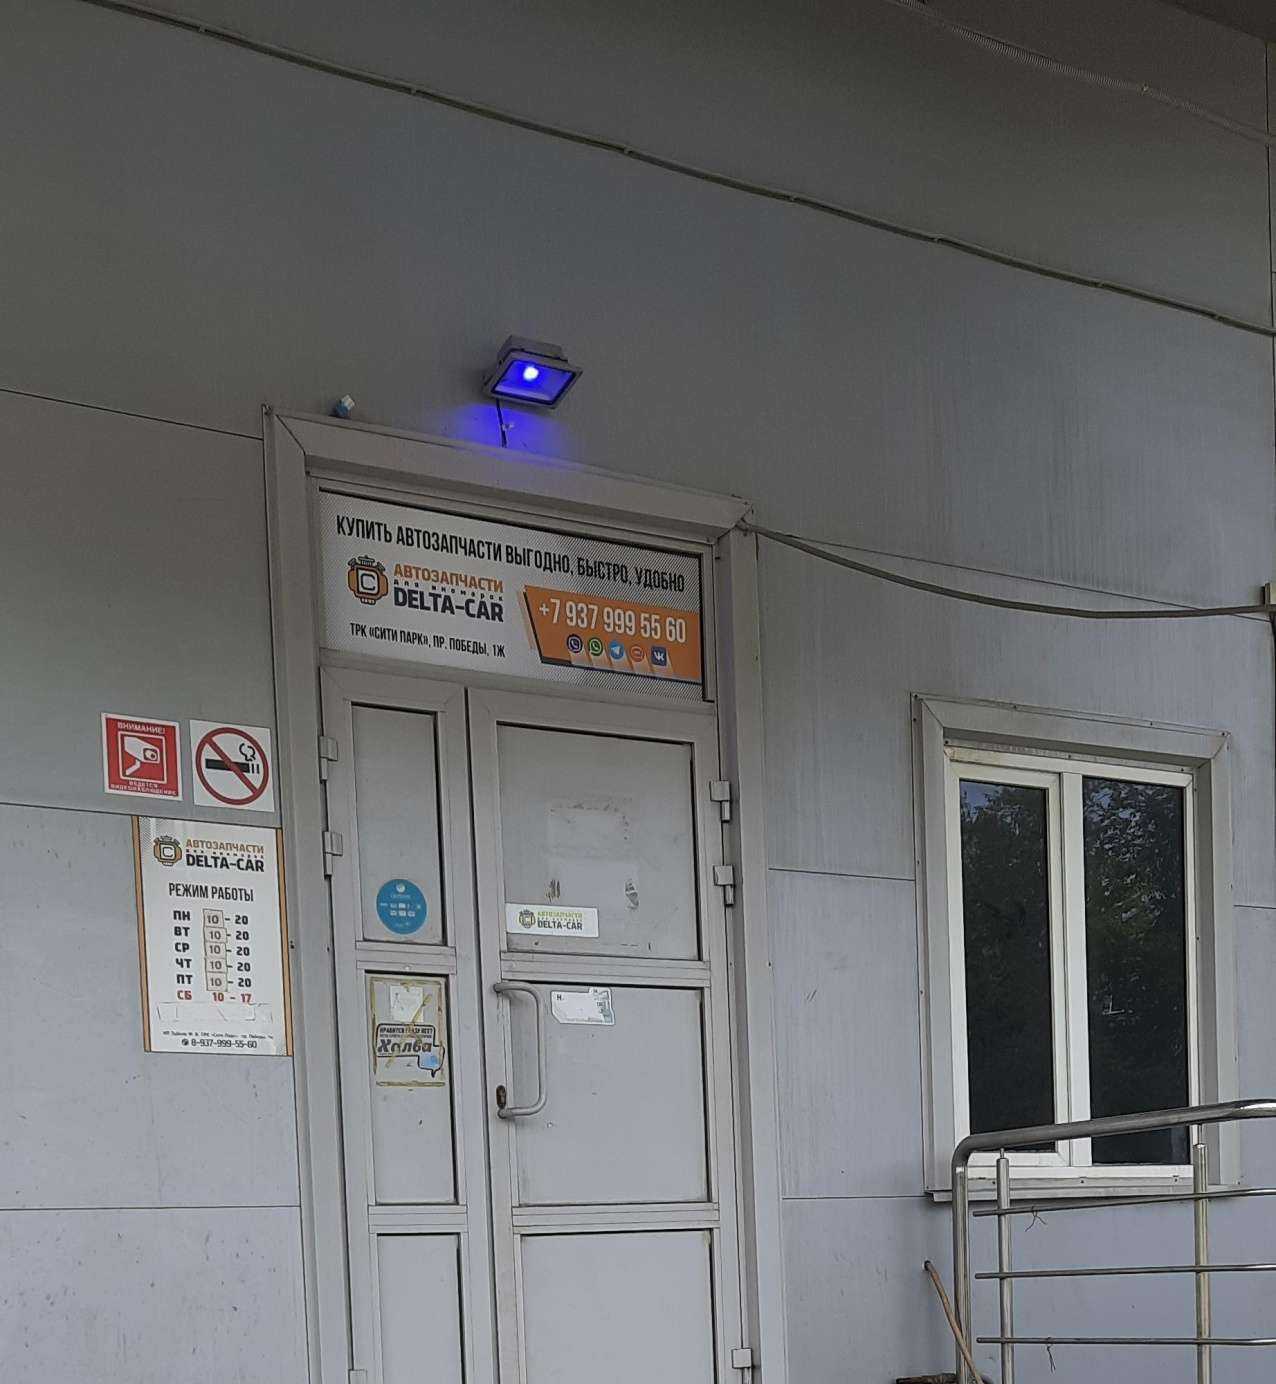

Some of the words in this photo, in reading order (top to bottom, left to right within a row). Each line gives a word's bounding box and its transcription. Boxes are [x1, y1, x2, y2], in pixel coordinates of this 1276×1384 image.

[336, 514, 393, 543] КУПИТЬ
[396, 525, 502, 562] АВТОЗАПЧАСТИ
[505, 544, 574, 576] ВЫГОДНО,
[577, 556, 632, 586] БЫСТРО,
[634, 566, 685, 593] УДОБНО
[393, 562, 504, 594] АВТОЗАПЧАСТИ
[393, 586, 504, 623] DELTA-CAR
[539, 597, 561, 624] +7
[565, 600, 599, 630] 937
[603, 607, 636, 637] 999
[640, 612, 661, 643] 55
[665, 616, 687, 644] 60
[349, 622, 367, 638] ТРК
[368, 626, 399, 643] «СИТИ
[492, 644, 506, 658] 1Ж
[186, 838, 265, 855] АВТОЗАПЧАСТИ
[186, 853, 265, 873] DELTA-CAR
[168, 882, 209, 899] РЕЖИМ
[211, 886, 255, 902] РАБОТЫ
[173, 910, 191, 921] ПН
[207, 914, 220, 925] 10
[234, 914, 249, 926] 20
[537, 919, 583, 931] DELTA-CAR
[174, 926, 190, 937] ВТ
[209, 930, 222, 940] 10
[235, 930, 250, 941] 20
[174, 942, 190, 953] СР
[209, 944, 221, 955] 10
[236, 946, 250, 957] 20
[175, 957, 192, 969] ЧТ
[209, 960, 222, 970] 10
[236, 961, 251, 972] 20
[176, 974, 193, 985] ПТ
[210, 977, 222, 987] 10
[237, 977, 252, 988] 20
[176, 990, 193, 1001] СБ
[212, 992, 225, 1002] 10
[240, 993, 252, 1003] 17
